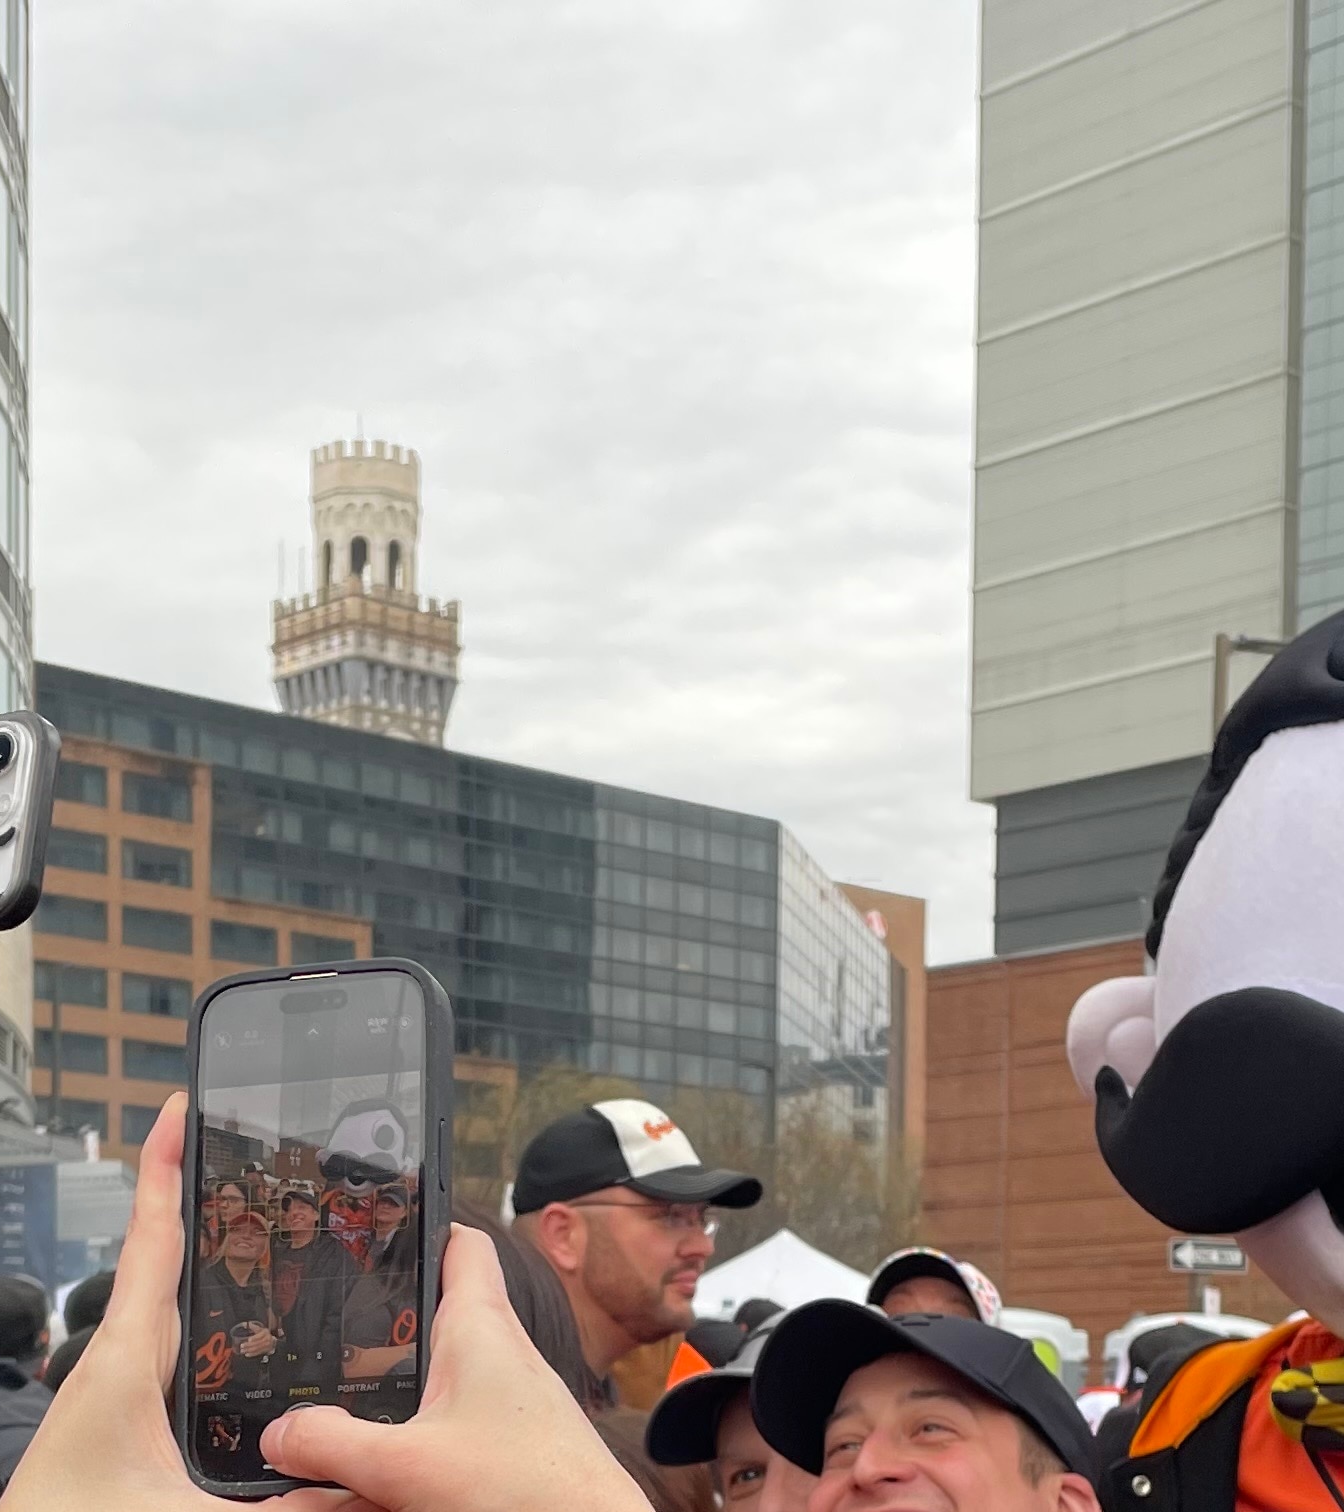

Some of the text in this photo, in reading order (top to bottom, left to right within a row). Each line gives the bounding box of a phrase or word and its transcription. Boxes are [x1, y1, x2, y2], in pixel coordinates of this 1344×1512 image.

[245, 1388, 273, 1400] VIDEO
[289, 1386, 321, 1396] PHOTO
[337, 1381, 381, 1393] PORTRAIT
